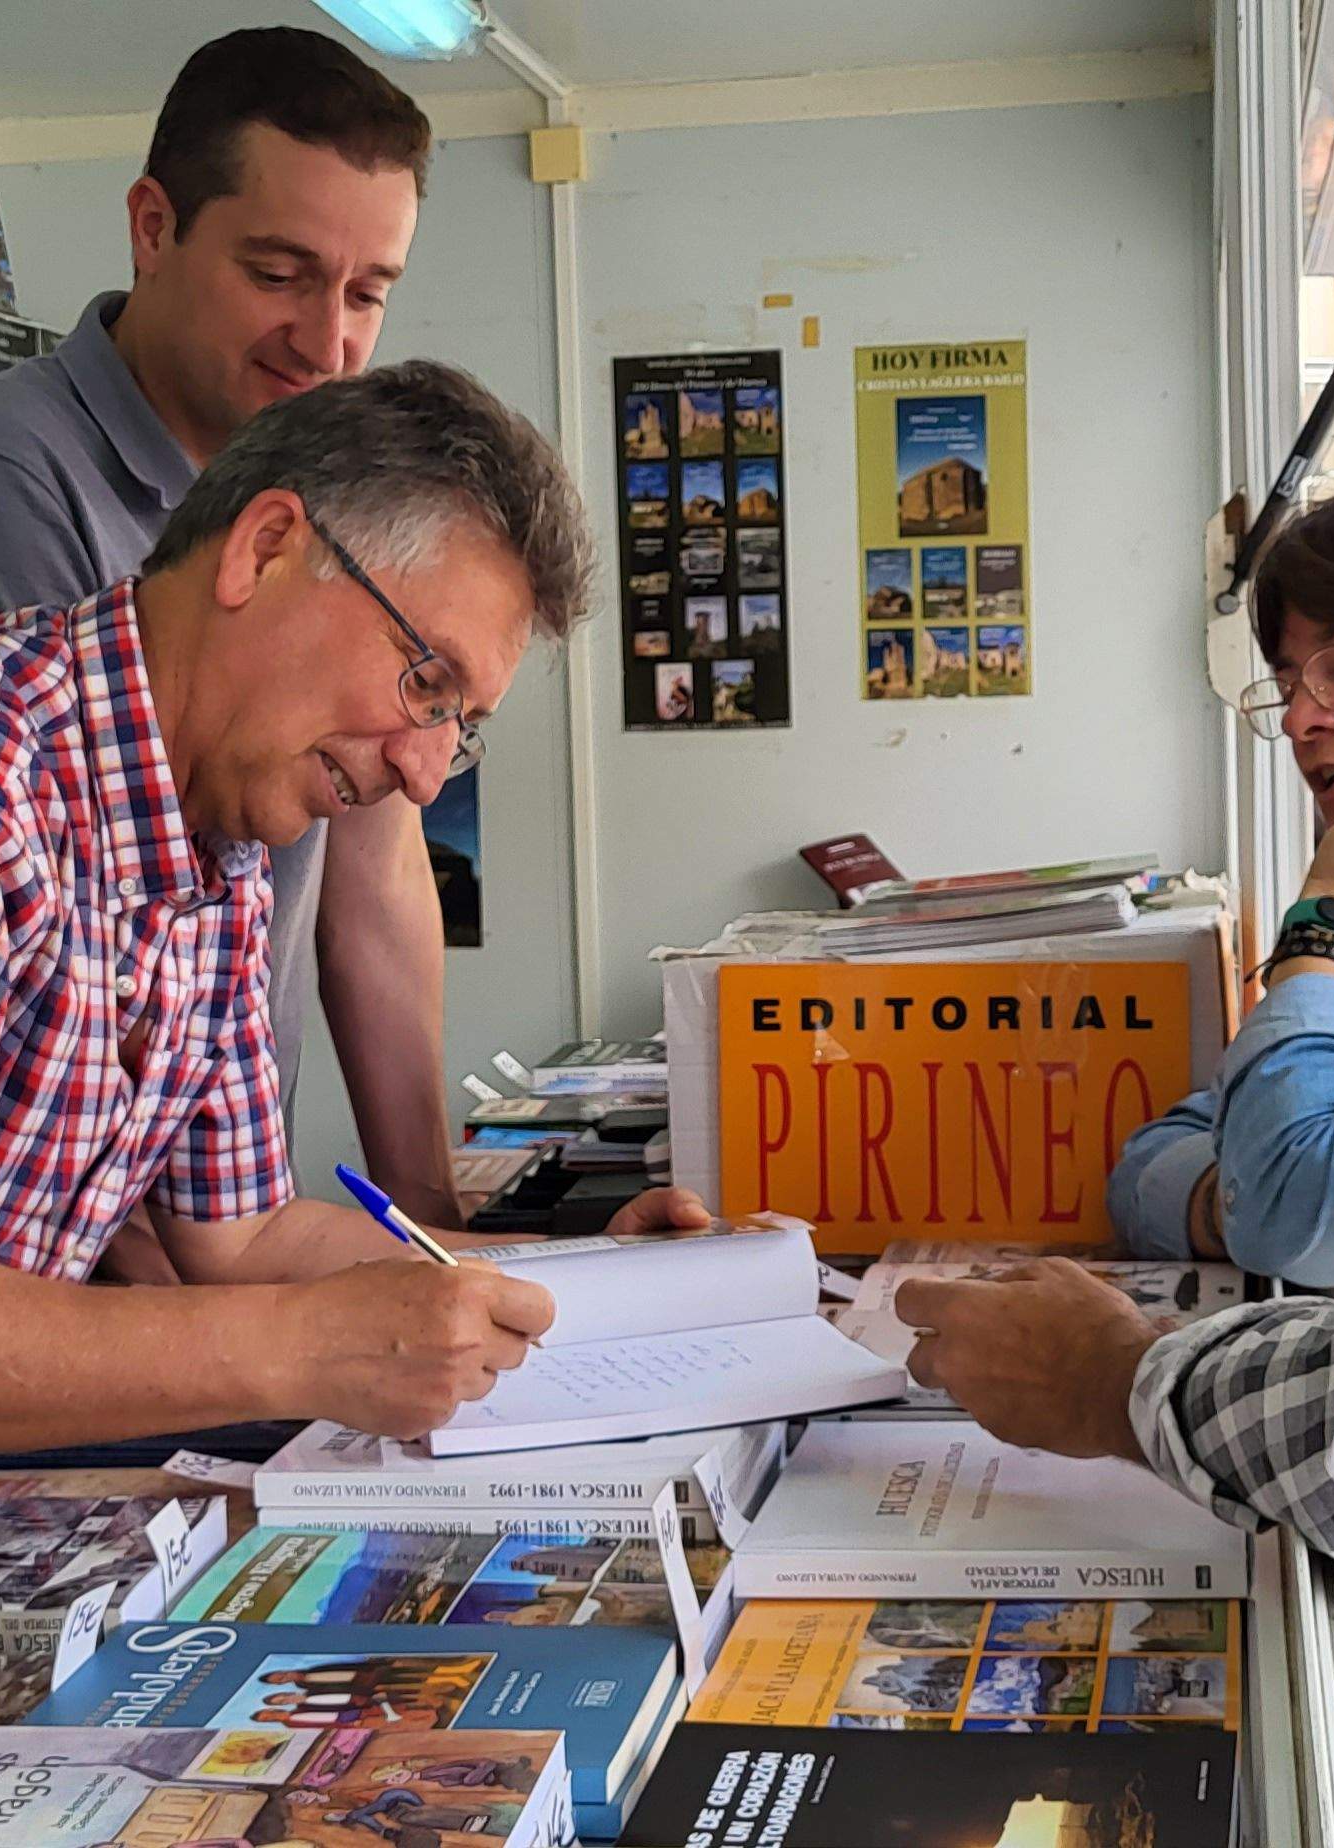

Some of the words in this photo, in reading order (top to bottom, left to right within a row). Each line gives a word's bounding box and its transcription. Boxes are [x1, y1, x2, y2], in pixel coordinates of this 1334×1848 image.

[872, 351, 923, 371] HOY
[930, 348, 1009, 369] FIRMA
[753, 996, 1154, 1031] EDITORIAL
[751, 1057, 1154, 1224] PIRINEO
[294, 1484, 342, 1496] LIZANO
[345, 1484, 391, 1496] ALVIRA
[396, 1484, 466, 1497] FERNANDO
[489, 1483, 564, 1498] 1981-1992
[571, 1484, 643, 1498] HUESCA
[876, 1460, 926, 1516] HUESCA
[495, 1519, 570, 1535] 1981-1992
[576, 1519, 650, 1533] HUESCA
[1076, 1567, 1165, 1587] HUESCA
[24, 1617, 64, 1631] ISTORIA
[15, 1633, 61, 1651] UESCA
[705, 1749, 752, 1807] GUERRA
[735, 1751, 784, 1819] CORAZÓN
[754, 1752, 817, 1848] LTOARAGONÉS
[693, 1807, 726, 1830] DE
[722, 1820, 756, 1843] UN
